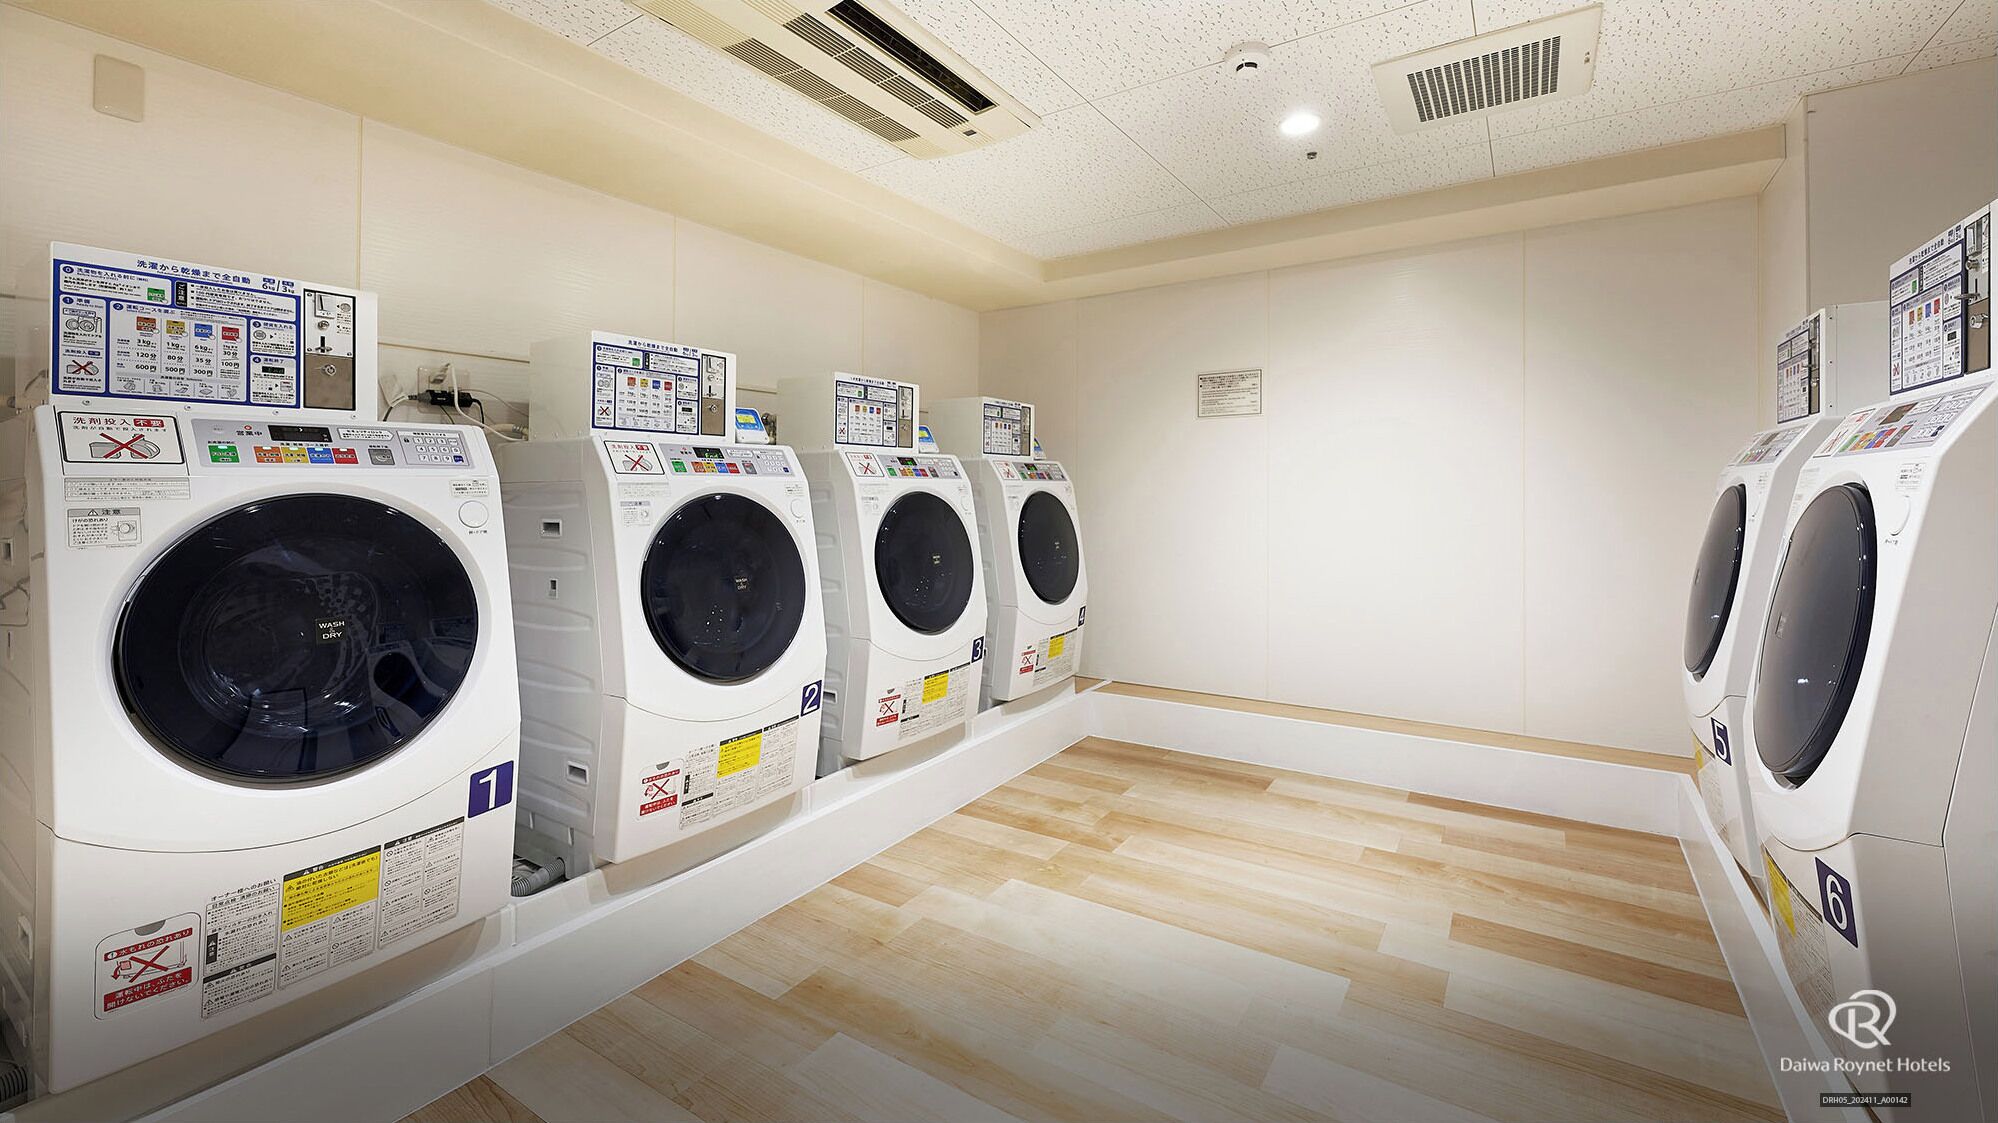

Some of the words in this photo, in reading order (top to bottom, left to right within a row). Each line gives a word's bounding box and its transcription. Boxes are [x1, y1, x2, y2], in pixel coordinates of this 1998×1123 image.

[136, 259, 251, 284] 洗濯から乾燥まで全自動
[72, 416, 131, 427] 洗剤投入
[136, 418, 163, 428] 不要
[974, 640, 982, 660] 3
[803, 684, 818, 714] 2
[1713, 720, 1727, 760] 5
[479, 768, 497, 810] 1
[1826, 874, 1848, 931] 6
